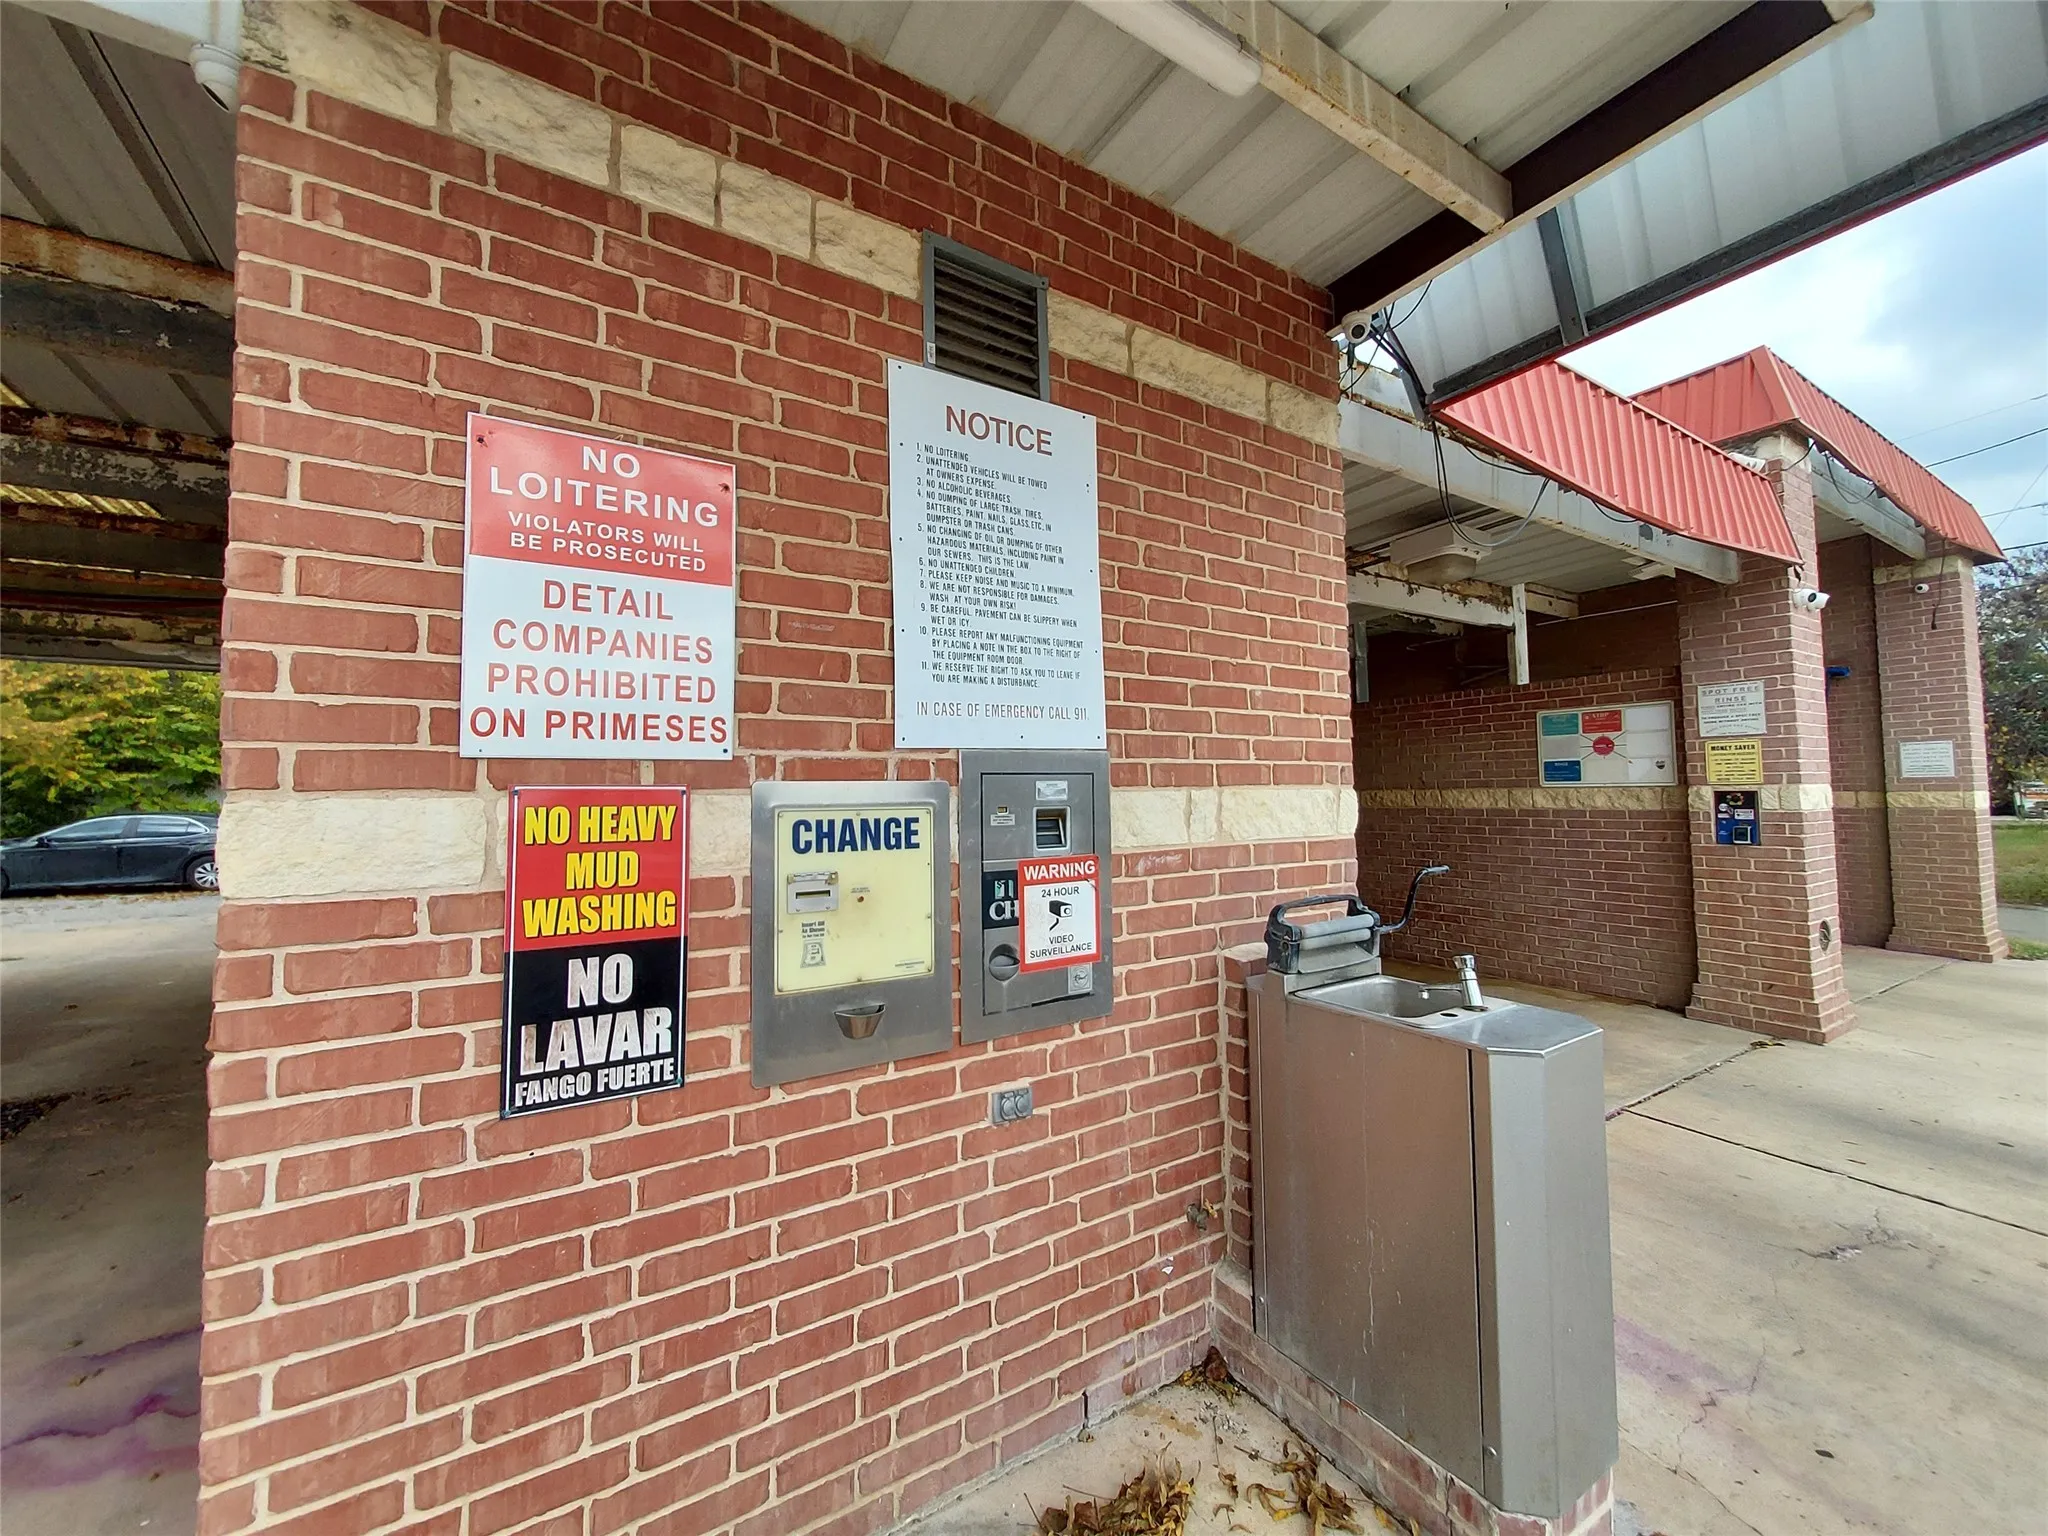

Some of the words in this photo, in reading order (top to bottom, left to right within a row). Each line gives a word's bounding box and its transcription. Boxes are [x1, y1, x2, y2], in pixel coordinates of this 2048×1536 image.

[946, 405, 1052, 456] NOTICE
[582, 446, 640, 478] NO
[925, 444, 933, 453] NO
[936, 447, 971, 461] LOITERING.
[925, 456, 968, 472] UNATTENDED
[970, 466, 999, 479] VEHICLES
[1002, 472, 1015, 483] WILL
[1018, 476, 1025, 485] BE
[1028, 478, 1047, 489] TOWED
[926, 468, 934, 476] AT
[937, 469, 964, 483] OWNERS
[967, 476, 996, 489] EXPENSE.
[491, 466, 719, 527] LOITERING
[926, 479, 935, 488] NO
[938, 481, 973, 495] ALCOHOLIC
[975, 488, 1012, 503] BEVERAGES.
[508, 511, 644, 544] VIOLATORS
[654, 533, 704, 553] WILL
[927, 513, 961, 526] DUMPSTER
[964, 520, 972, 528] OR
[975, 521, 995, 532] TRASH
[997, 525, 1015, 536] CANS.
[927, 524, 936, 533] NO
[940, 526, 972, 539] CHANGING
[975, 532, 982, 540] OF
[985, 534, 994, 543] OIL
[997, 536, 1004, 544] OR
[1007, 538, 1033, 549] DUMPING
[1036, 542, 1042, 550] OF
[1045, 544, 1062, 554] OTHER
[511, 532, 542, 550] BE
[553, 538, 706, 572] PROSECUTED
[928, 547, 941, 556] OUR
[979, 554, 992, 564] THIS
[995, 557, 1001, 565] IS
[1003, 558, 1014, 567] THE
[928, 559, 937, 567] NO
[941, 560, 982, 573] UNATTENDED
[929, 570, 952, 581] PLEASE
[956, 573, 972, 582] KEEP
[975, 576, 993, 585] NOISE
[996, 579, 1008, 587] AND
[1011, 580, 1029, 590] MUSIC
[1032, 583, 1039, 591] TO
[929, 581, 939, 590] WE
[943, 583, 955, 592] ARE
[958, 585, 970, 594] NOT
[973, 586, 1014, 599] RESPONSIBLE
[1017, 592, 1028, 600] FOR
[543, 579, 673, 621] DETAIL
[929, 592, 948, 602] WASH
[954, 595, 961, 603] AT
[964, 597, 980, 605] YOUR
[983, 599, 997, 607] OWN
[930, 604, 938, 612] BE
[975, 609, 1006, 619] PAVEMENT
[1009, 612, 1021, 621] CAN
[1024, 614, 1031, 622] BE
[1033, 615, 1059, 625] SLIPPERY
[1061, 619, 1077, 627] WHEN
[931, 615, 945, 624] WET
[948, 617, 956, 625] OR
[493, 618, 713, 664] COMPANIES
[932, 627, 956, 637] PLEASE
[960, 629, 983, 639] REPORT
[986, 632, 997, 640] ANY
[1000, 633, 1050, 646] MALFUNCTIONING
[1053, 638, 1083, 649] EQUIPMENT
[932, 639, 940, 647] BY
[943, 639, 970, 649] PLACING
[973, 642, 977, 650] A
[980, 643, 995, 652] NOTE
[998, 644, 1004, 652] IN
[1007, 645, 1017, 653] THE
[1020, 646, 1031, 654] BOX
[1034, 647, 1041, 655] TO
[1043, 648, 1053, 656] THE
[1056, 649, 1071, 658] RIGHT
[1074, 650, 1080, 658] OF
[933, 650, 944, 659] THE
[948, 651, 984, 661] EQUIPMENT
[987, 654, 1004, 663] ROOM
[932, 662, 942, 670] WE
[945, 663, 974, 672] RESERVE
[977, 665, 988, 673] THE
[991, 666, 1008, 674] RIGHT
[1011, 667, 1018, 675] TO
[1021, 668, 1032, 676] ASK
[1035, 669, 1045, 677] YOU
[1048, 670, 1054, 678] TO
[1057, 671, 1073, 679] LEAVE
[1075, 671, 1080, 679] IF
[932, 673, 944, 682] YOU
[948, 675, 960, 683] ARE
[963, 675, 988, 685] MAKING
[991, 677, 995, 685] A
[488, 662, 716, 704] PROHIBITED
[917, 701, 927, 715] IN
[933, 702, 962, 716] CASE
[967, 703, 979, 717] OF
[985, 704, 1044, 718] EMERGENCY
[1049, 706, 1071, 720] CALL
[1715, 696, 1746, 704] RINSE
[470, 706, 525, 738] ON
[545, 710, 728, 744] PRIMESES
[524, 806, 571, 845] NO
[579, 804, 677, 843] HEAVY
[792, 816, 920, 855] CHANGE
[565, 850, 639, 890] MUD
[1024, 860, 1095, 881] WARNING
[1041, 889, 1051, 898] 24
[1053, 886, 1080, 896] HOUR
[522, 890, 677, 939] WASHING
[1030, 942, 1092, 958] SURVEILLANCE
[1049, 934, 1074, 945] VIDEO
[566, 953, 634, 1009] NO
[519, 1006, 673, 1076] LAVAR
[514, 1070, 592, 1108] FANGO
[597, 1057, 675, 1093] FUERTE
